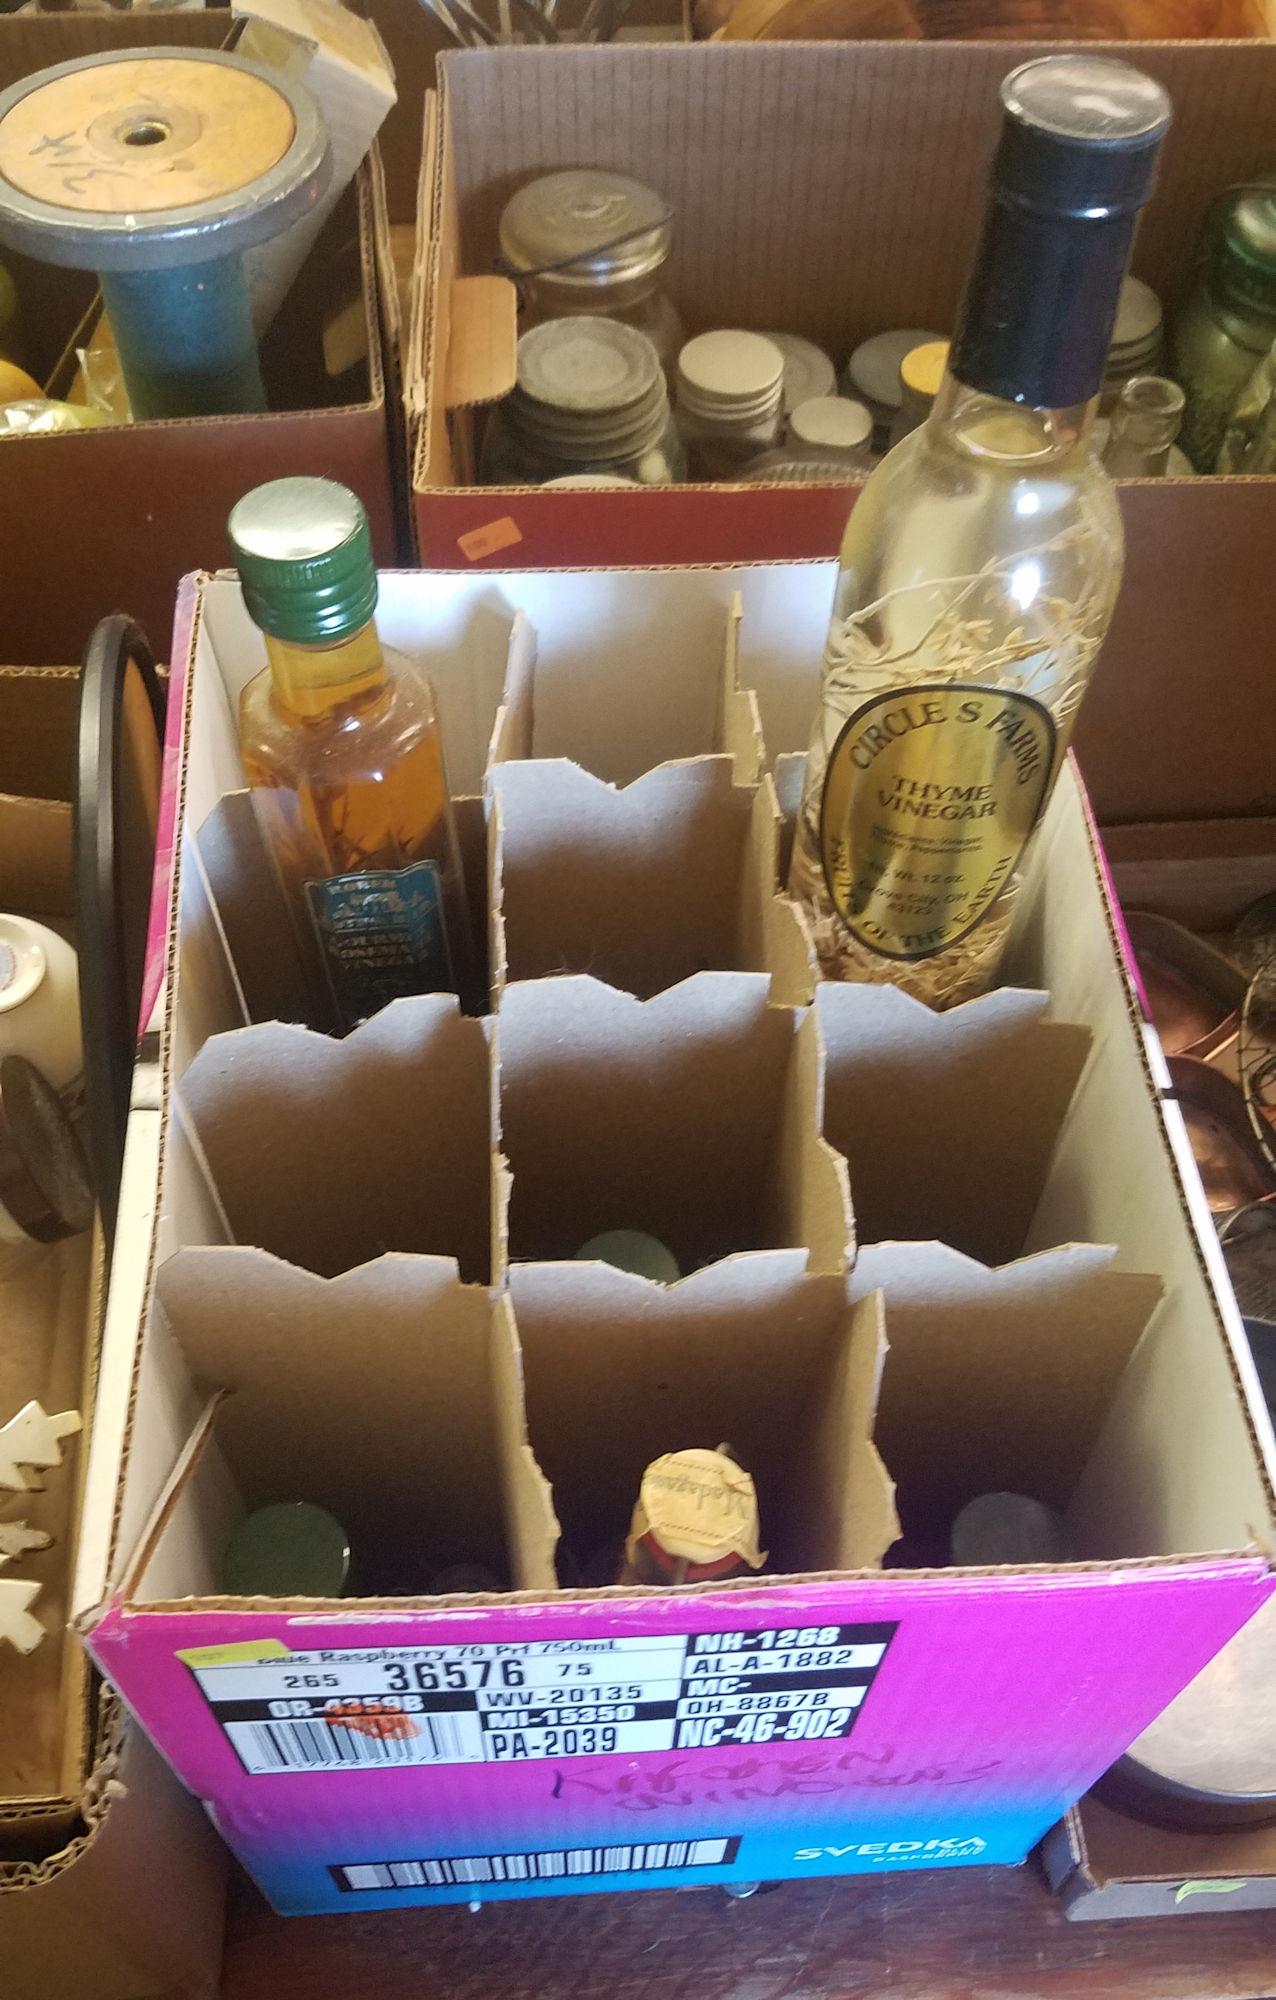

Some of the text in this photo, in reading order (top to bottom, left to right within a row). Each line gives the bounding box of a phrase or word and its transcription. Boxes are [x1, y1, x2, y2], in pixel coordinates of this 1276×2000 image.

[850, 701, 1042, 786] CIRCLE S FARMS
[891, 775, 993, 801] THYME
[878, 789, 998, 821] VINEGAR
[952, 856, 1013, 923] EARTH
[320, 1648, 446, 1664] Raspberry
[457, 1645, 484, 1657] 70
[496, 1644, 531, 1656] Prf
[541, 1640, 622, 1653] 750mL
[694, 1626, 841, 1654] NH-1268
[283, 1659, 593, 1691] 265 36576 75
[693, 1650, 853, 1674] AL-A-1882
[487, 1685, 642, 1707] WV-20135
[687, 1676, 752, 1697] MC-
[487, 1705, 636, 1729] MI-15350
[677, 1707, 852, 1749] NC-46-902
[492, 1727, 617, 1759] PA-2039
[793, 1836, 988, 1861] SVEDKA
